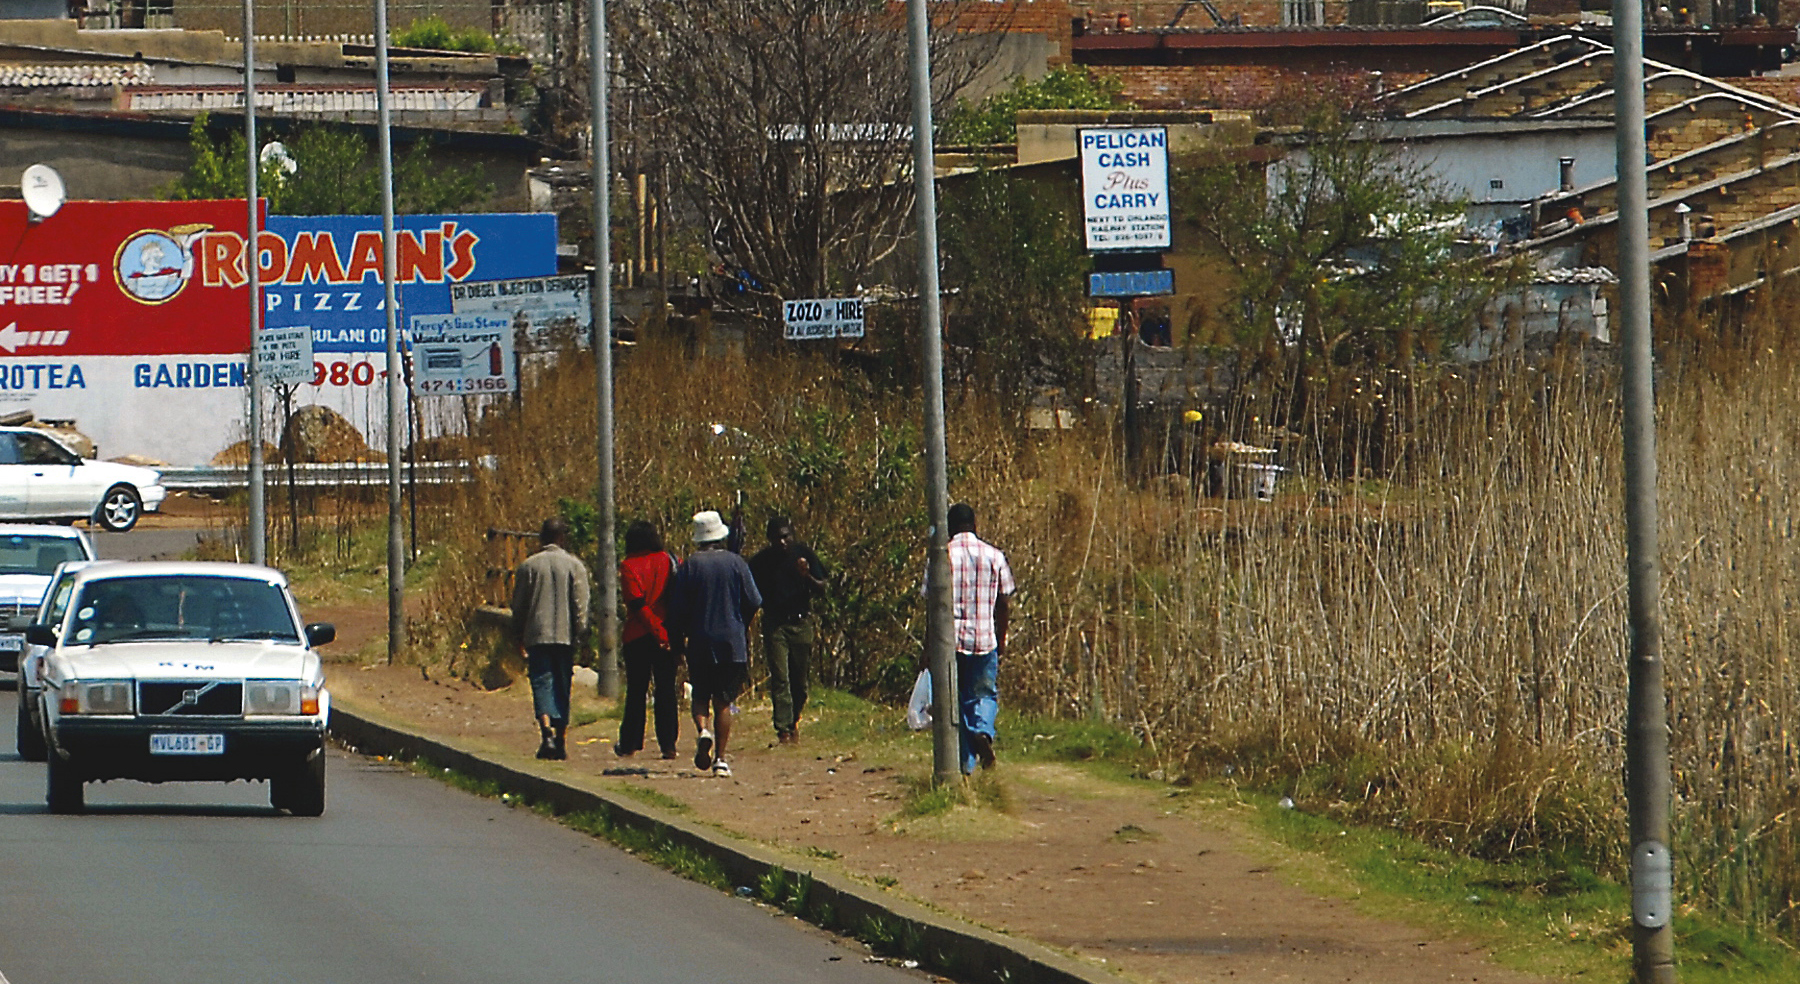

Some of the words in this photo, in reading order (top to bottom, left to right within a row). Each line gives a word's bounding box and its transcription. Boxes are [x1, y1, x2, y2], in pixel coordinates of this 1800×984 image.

[1084, 133, 1164, 149] PELICAN
[1098, 152, 1150, 168] CASH
[1102, 171, 1149, 190] Plus
[1094, 192, 1159, 209] CARRY
[202, 222, 480, 289] ROMAN'S
[21, 264, 36, 284] 1
[39, 264, 82, 283] GET
[84, 263, 99, 282] 1
[787, 302, 822, 322] ZOZO
[836, 300, 863, 321] HIRE
[412, 333, 501, 344] Manufacturers
